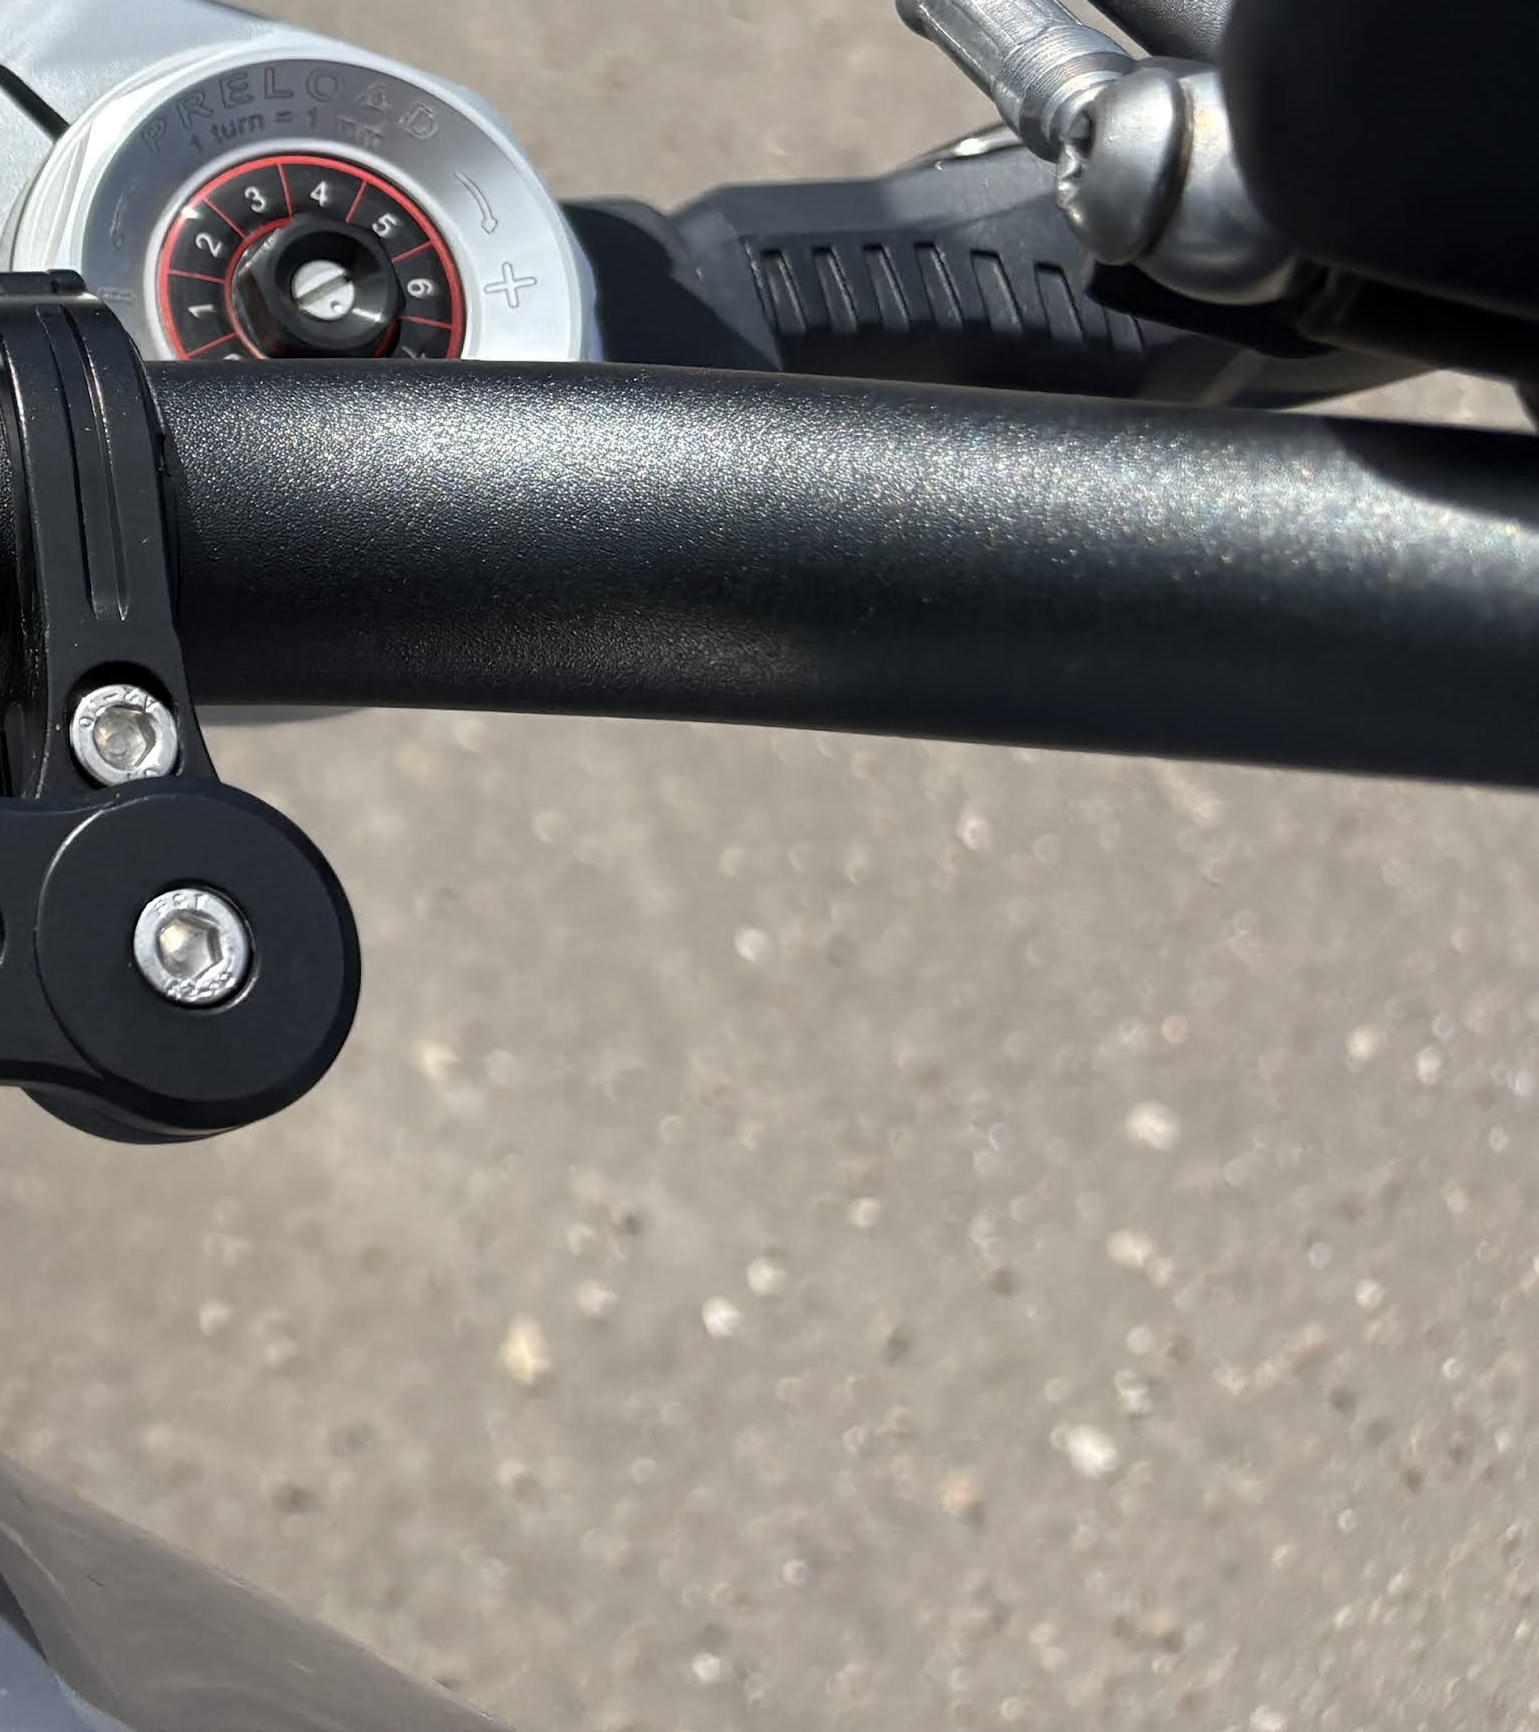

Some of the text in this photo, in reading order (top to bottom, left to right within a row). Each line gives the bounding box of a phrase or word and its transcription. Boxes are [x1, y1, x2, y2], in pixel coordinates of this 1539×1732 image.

[142, 66, 440, 156] PRELOAD
[188, 181, 433, 318] 1 2 3 4 5 6
